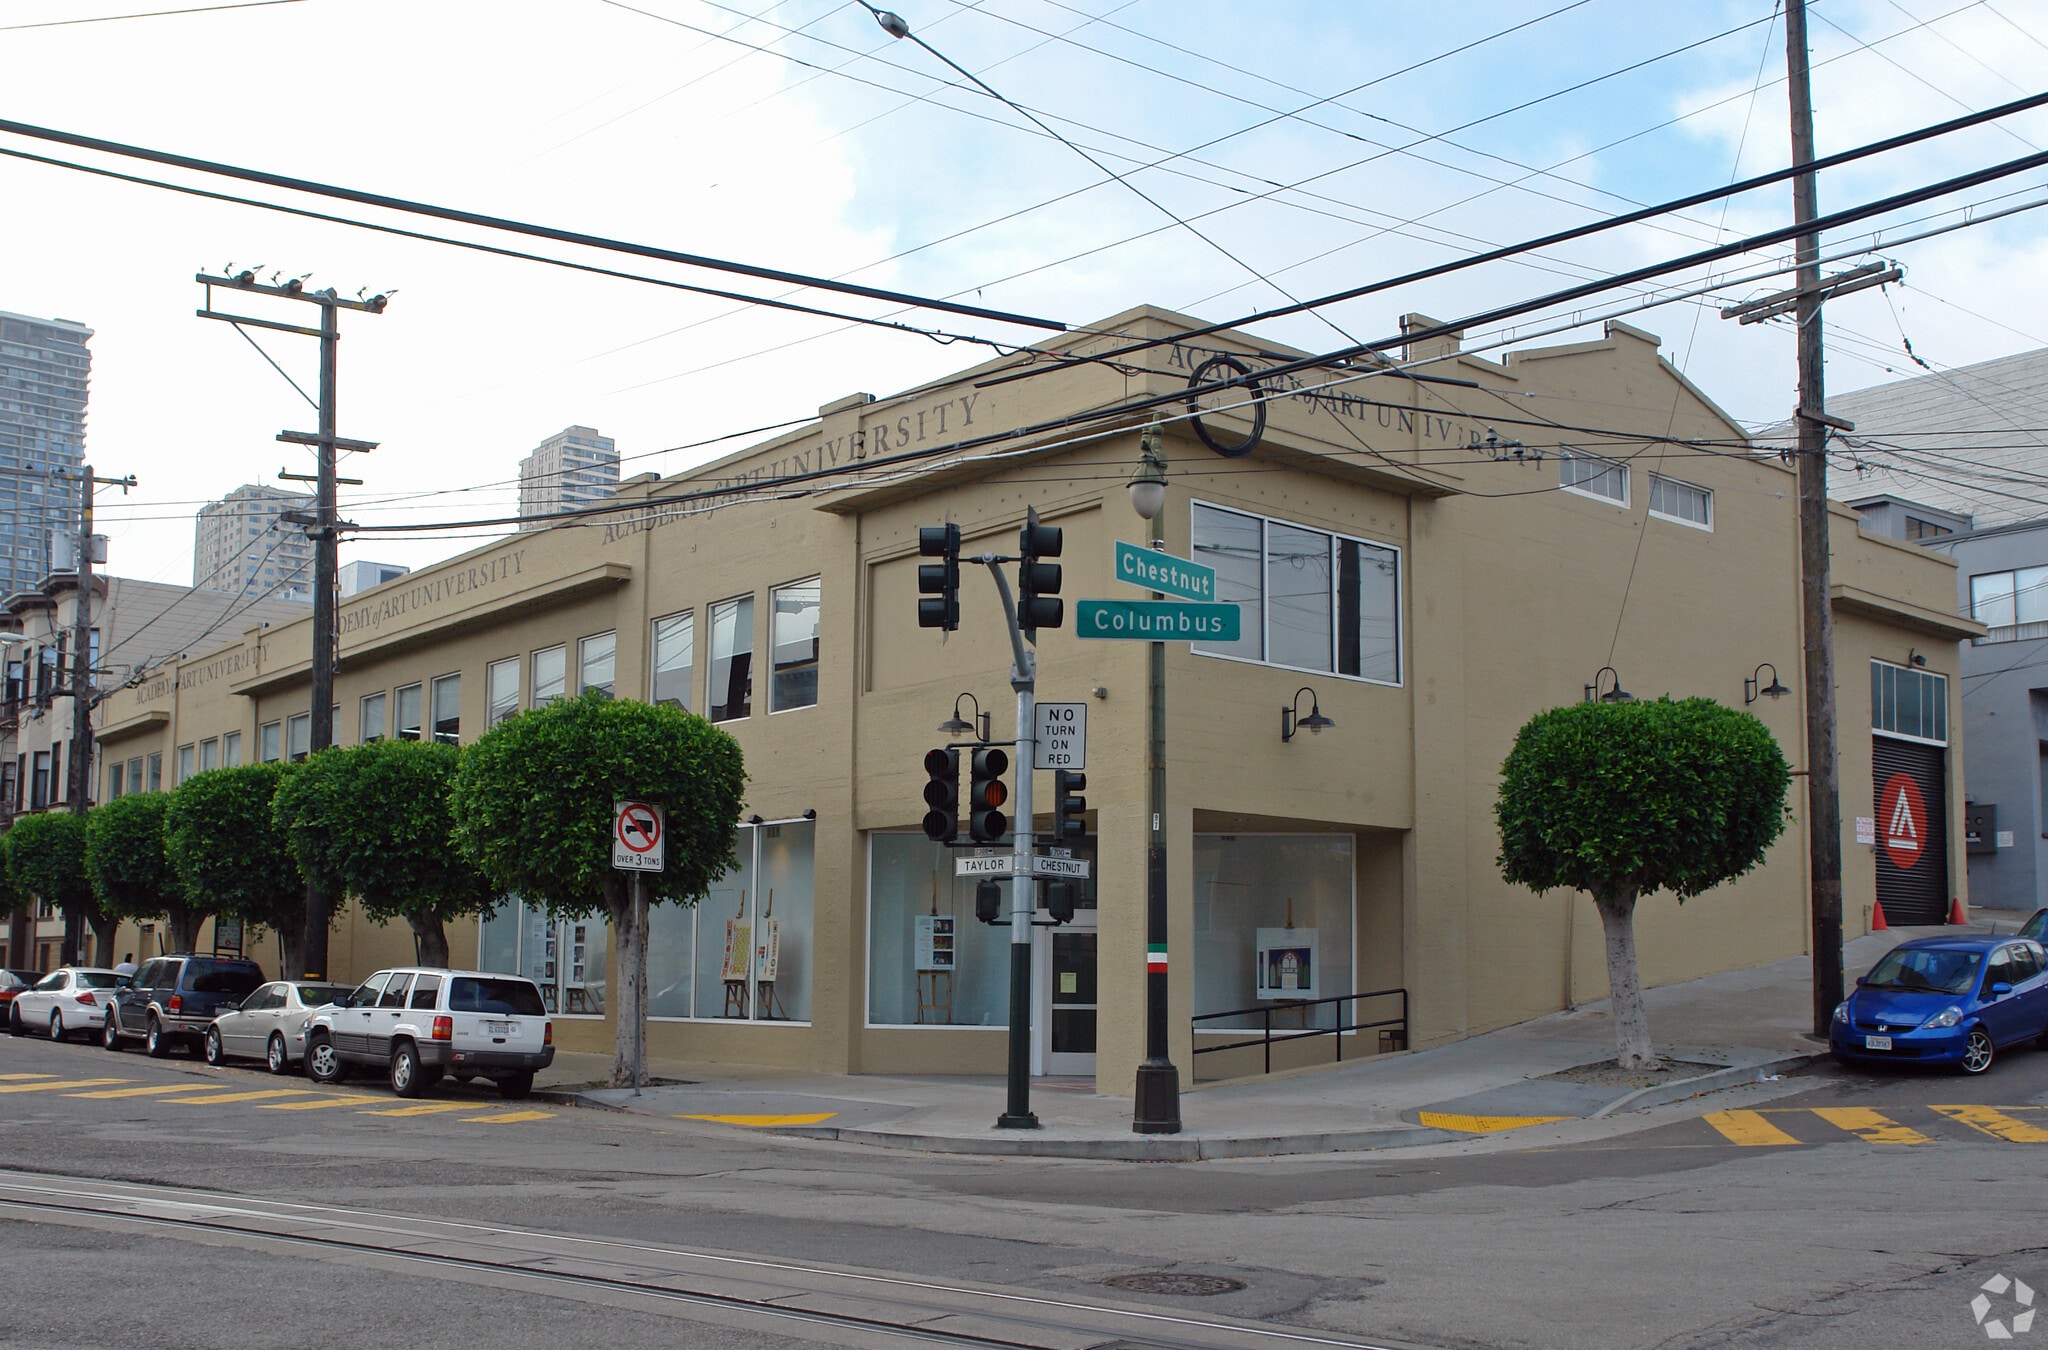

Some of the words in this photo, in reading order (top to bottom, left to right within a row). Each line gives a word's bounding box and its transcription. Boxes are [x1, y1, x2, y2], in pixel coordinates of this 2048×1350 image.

[1325, 387, 1370, 421] ART
[771, 392, 981, 489] UNIVERSITY
[1123, 552, 1209, 595] Chestnut
[382, 592, 410, 621] ART
[411, 550, 526, 610] UNIVERSITY
[1095, 609, 1222, 632] Columbus
[198, 643, 270, 686] UNIVERSITY
[1050, 709, 1074, 721] NO
[1045, 725, 1075, 736] TURN
[1051, 739, 1068, 750] ON
[1048, 753, 1071, 764] RED
[617, 854, 634, 864] OVER
[635, 853, 642, 866] 3
[644, 856, 660, 866] TONS
[965, 859, 1004, 871] TAYLOR
[1040, 859, 1081, 874] CHESTNUT
